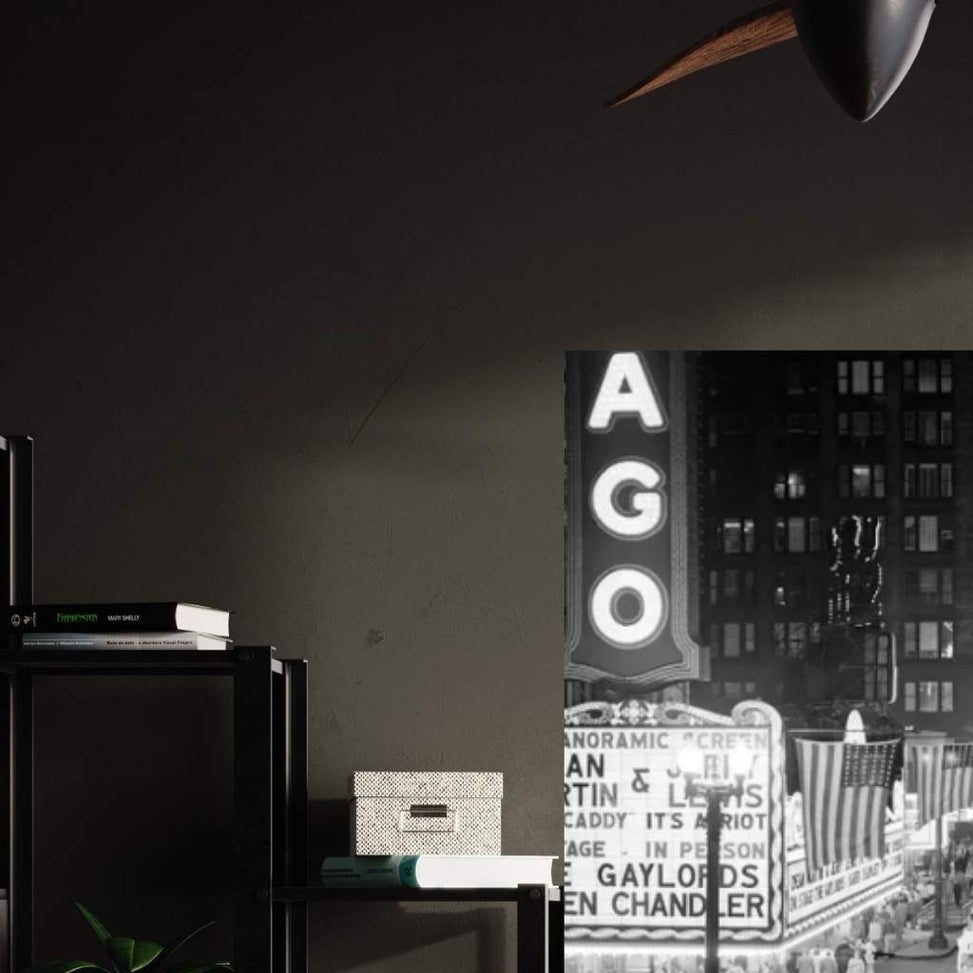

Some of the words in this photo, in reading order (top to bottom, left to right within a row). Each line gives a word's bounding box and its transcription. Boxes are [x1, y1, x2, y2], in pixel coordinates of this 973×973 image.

[588, 352, 664, 645] AGO
[566, 753, 604, 778] AN
[631, 768, 650, 793] &
[564, 812, 627, 829] CADDY
[564, 841, 606, 857] AGE
[646, 842, 667, 858] IN
[680, 842, 766, 858] PESON
[611, 891, 765, 918] CHANDER
